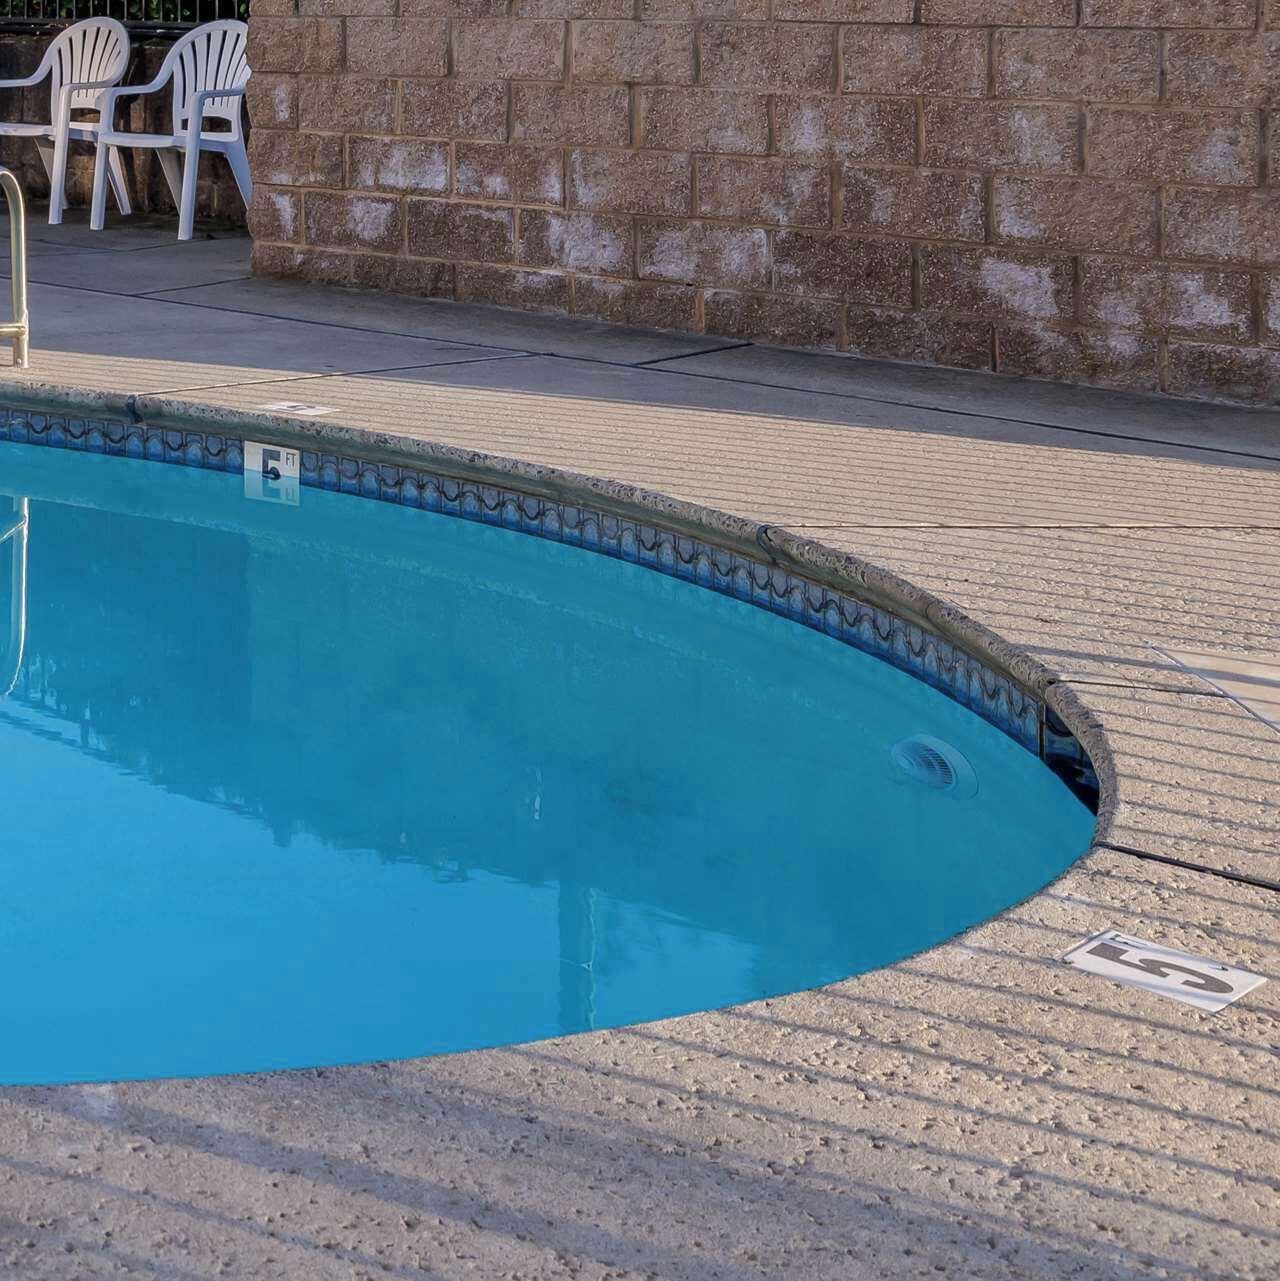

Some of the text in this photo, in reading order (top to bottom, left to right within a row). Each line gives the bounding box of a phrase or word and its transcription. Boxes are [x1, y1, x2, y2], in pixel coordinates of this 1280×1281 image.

[262, 447, 297, 481] 5 FT
[1085, 942, 1235, 994] 5
